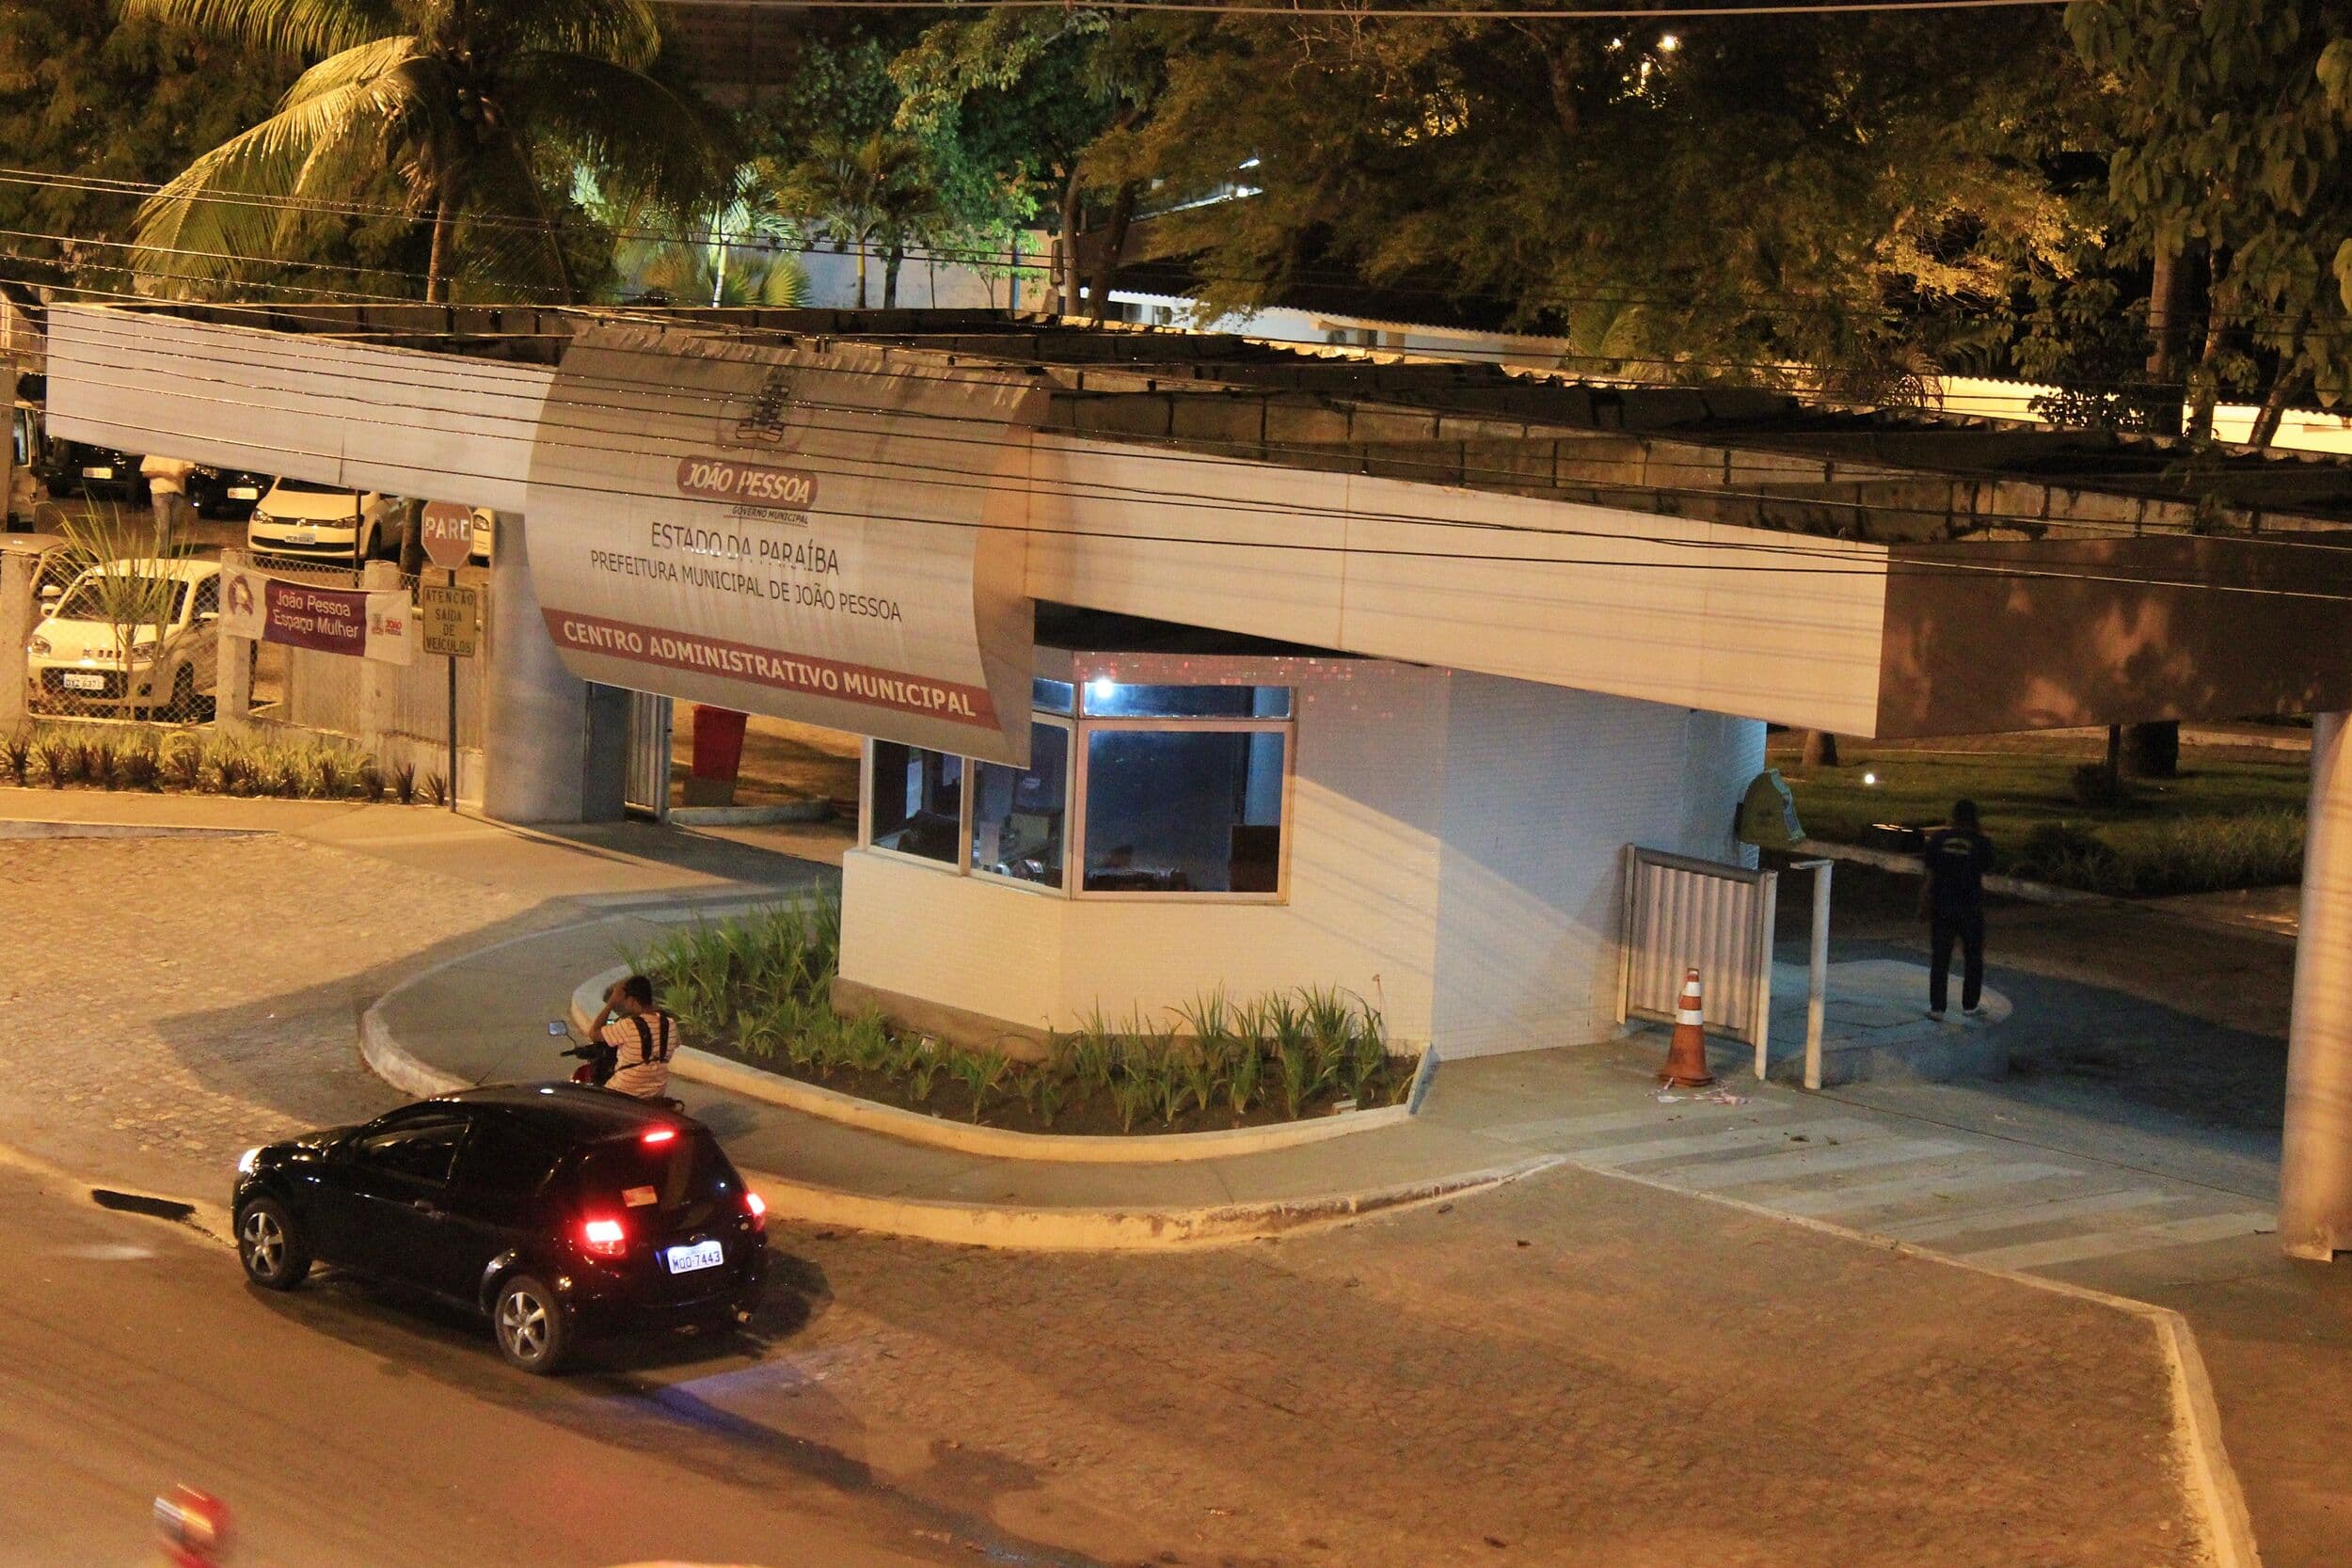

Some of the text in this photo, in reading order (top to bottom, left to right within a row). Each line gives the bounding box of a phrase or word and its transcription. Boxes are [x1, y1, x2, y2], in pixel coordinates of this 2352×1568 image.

[683, 463, 811, 504] JOÃO PESSOA
[424, 516, 469, 542] PARE
[732, 506, 809, 525] GOVERNO MUNICIPAL
[651, 522, 840, 576] ESTADO DA PARAÍBA
[591, 549, 903, 623] PREFEITURA MUNICIPAL DE JOÃO PESSOA
[277, 590, 352, 617] João Pessoa
[273, 609, 359, 639] Espaço Mulher
[442, 624, 454, 637] DE
[563, 621, 977, 717] CENTRO ADMINISTRATIVO MUNICIPAL
